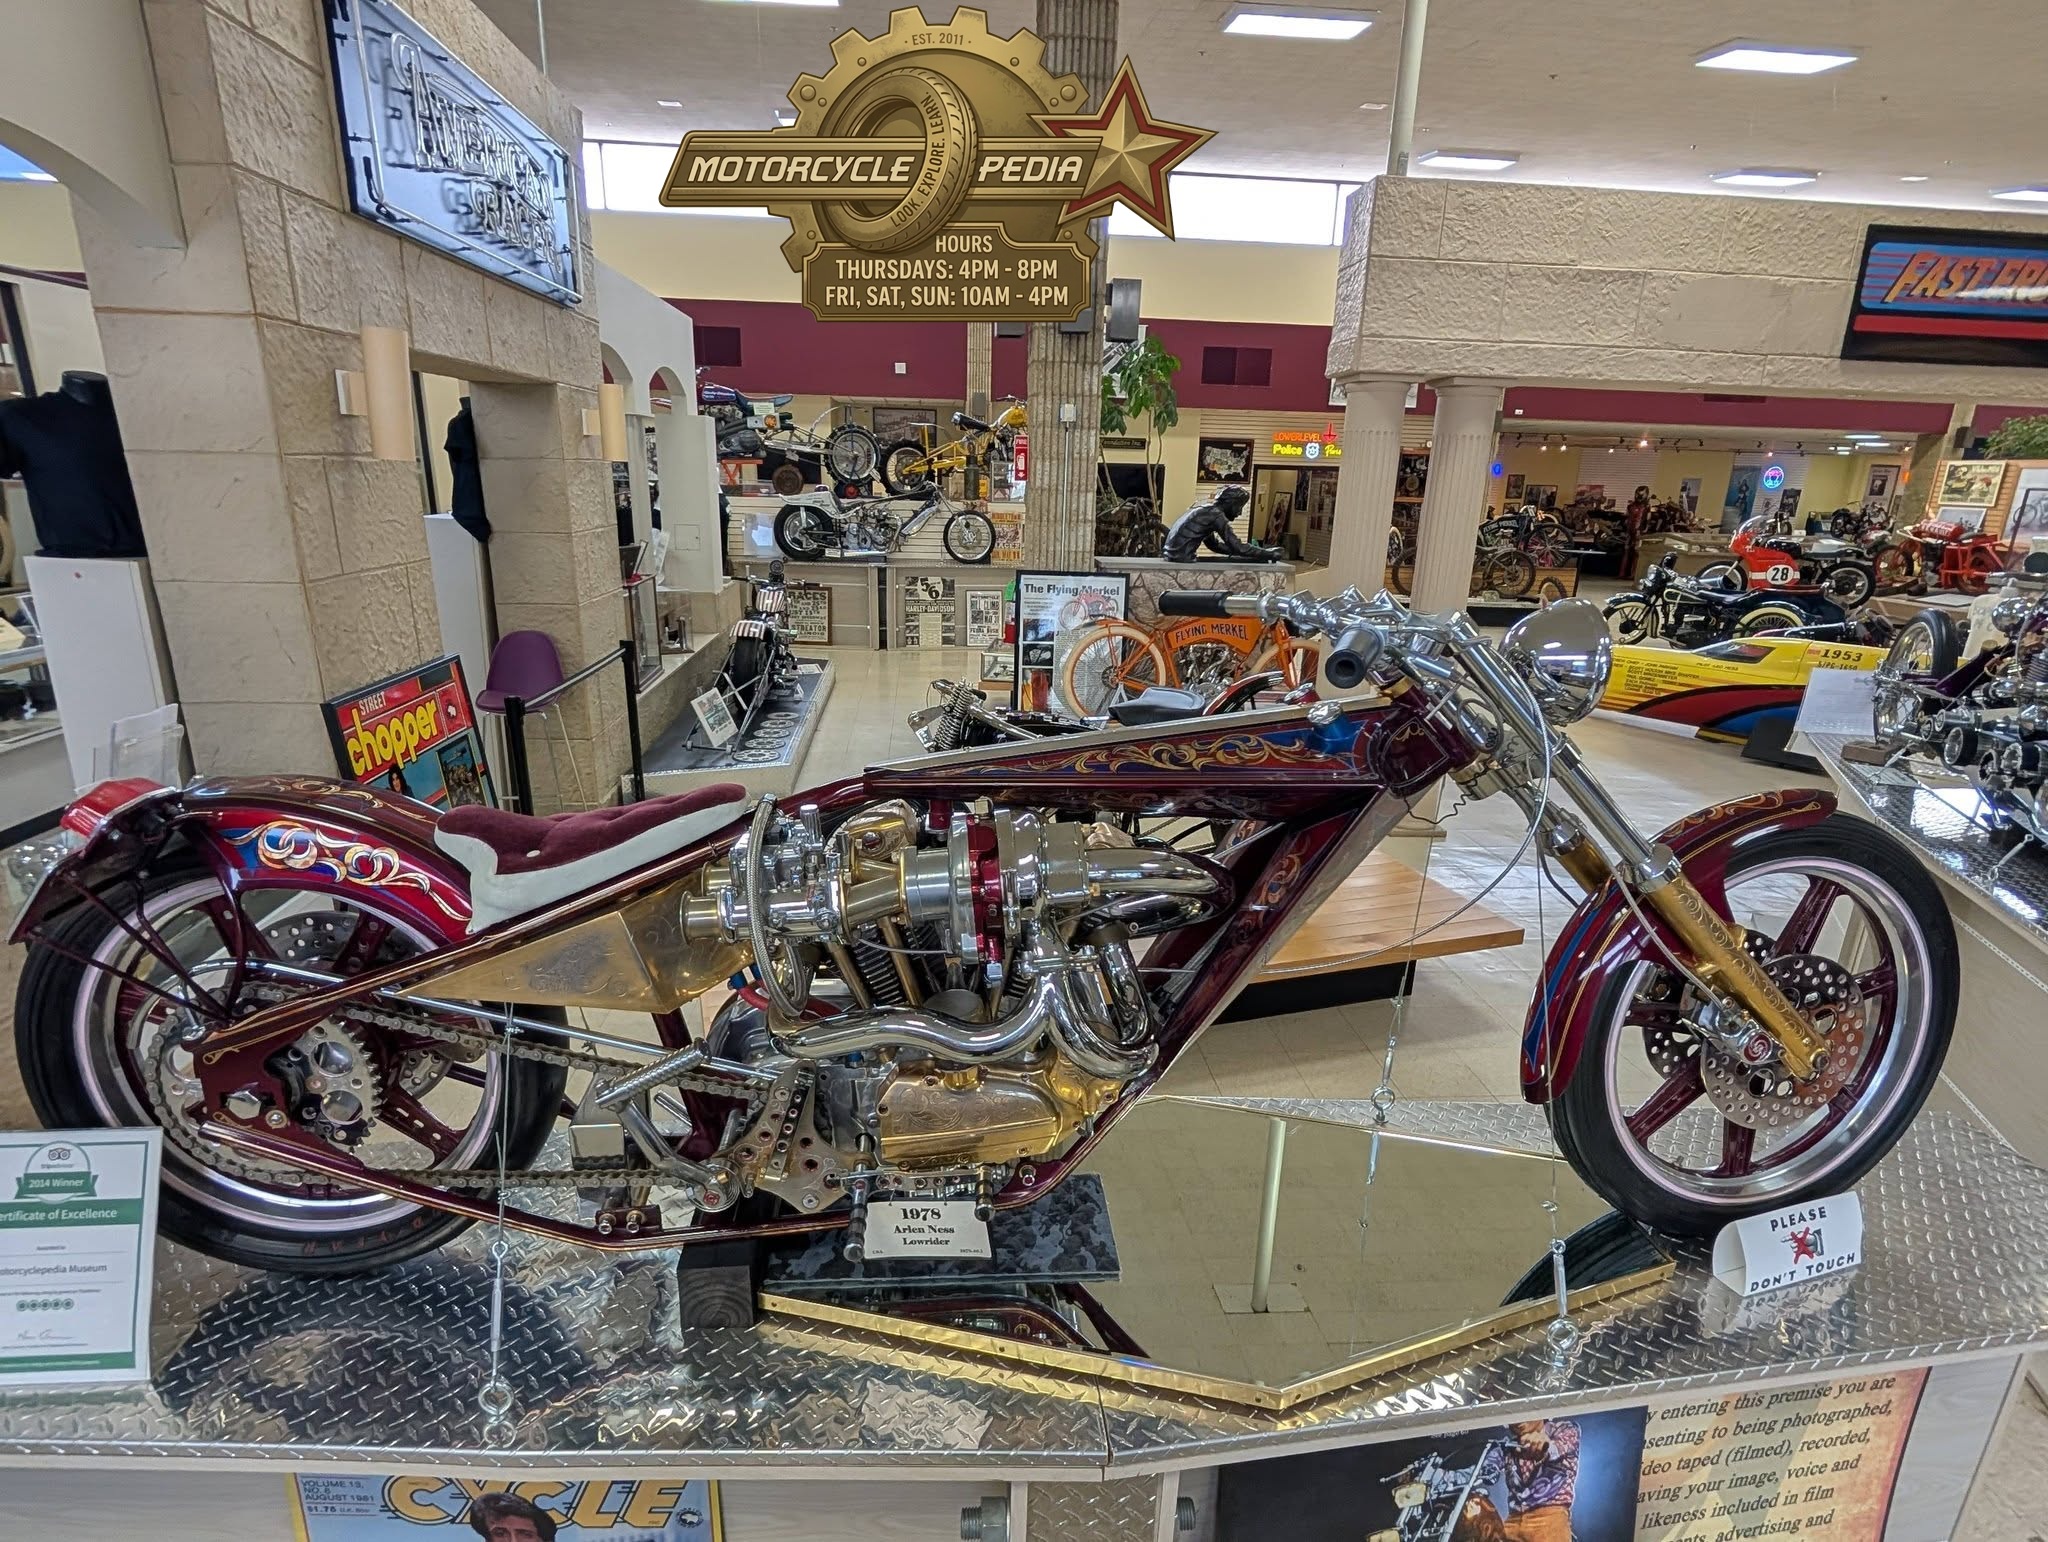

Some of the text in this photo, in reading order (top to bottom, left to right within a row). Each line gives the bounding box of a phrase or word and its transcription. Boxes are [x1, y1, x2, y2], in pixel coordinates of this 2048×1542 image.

[1273, 443, 1303, 455] Police
[1771, 567, 1789, 581] 28
[788, 591, 827, 601] RACES
[1023, 583, 1120, 597] The Flying Merkel
[905, 605, 955, 613] HARLEY-DAVIDSON
[1175, 623, 1249, 643] FLYING MERKEL
[1821, 649, 1863, 662] 1953
[358, 691, 387, 716] STREET
[346, 698, 438, 777] chopper
[29, 1179, 84, 1188] 2014 Winner
[0, 1208, 118, 1222] ertificate of Excellence
[900, 1207, 942, 1222] 1978
[1770, 1206, 1827, 1232] PLEASE
[894, 1225, 955, 1234] Arlen Ness
[903, 1237, 950, 1246] Lowrider
[0, 1264, 107, 1276] otorcyclepedia Museum
[1751, 1252, 1855, 1293] DON'T TOUCH
[1646, 1376, 1896, 1425] y entering this premise you are
[1711, 1425, 1728, 1440] to
[1732, 1417, 1777, 1438] being
[1779, 1400, 1893, 1433] photographed,
[1676, 1450, 1720, 1473] taped
[1725, 1440, 1794, 1467] (filmed),
[1799, 1428, 1871, 1453] recorded,
[302, 1480, 346, 1488] VOLUME
[1637, 1454, 1861, 1504] aving your image, voice and
[350, 1494, 374, 1502] 1981
[388, 1476, 689, 1530] CYCLE
[1640, 1485, 1835, 1530] likeness included in film
[1715, 1517, 1801, 1542] advertising
[1805, 1508, 1835, 1529] and
